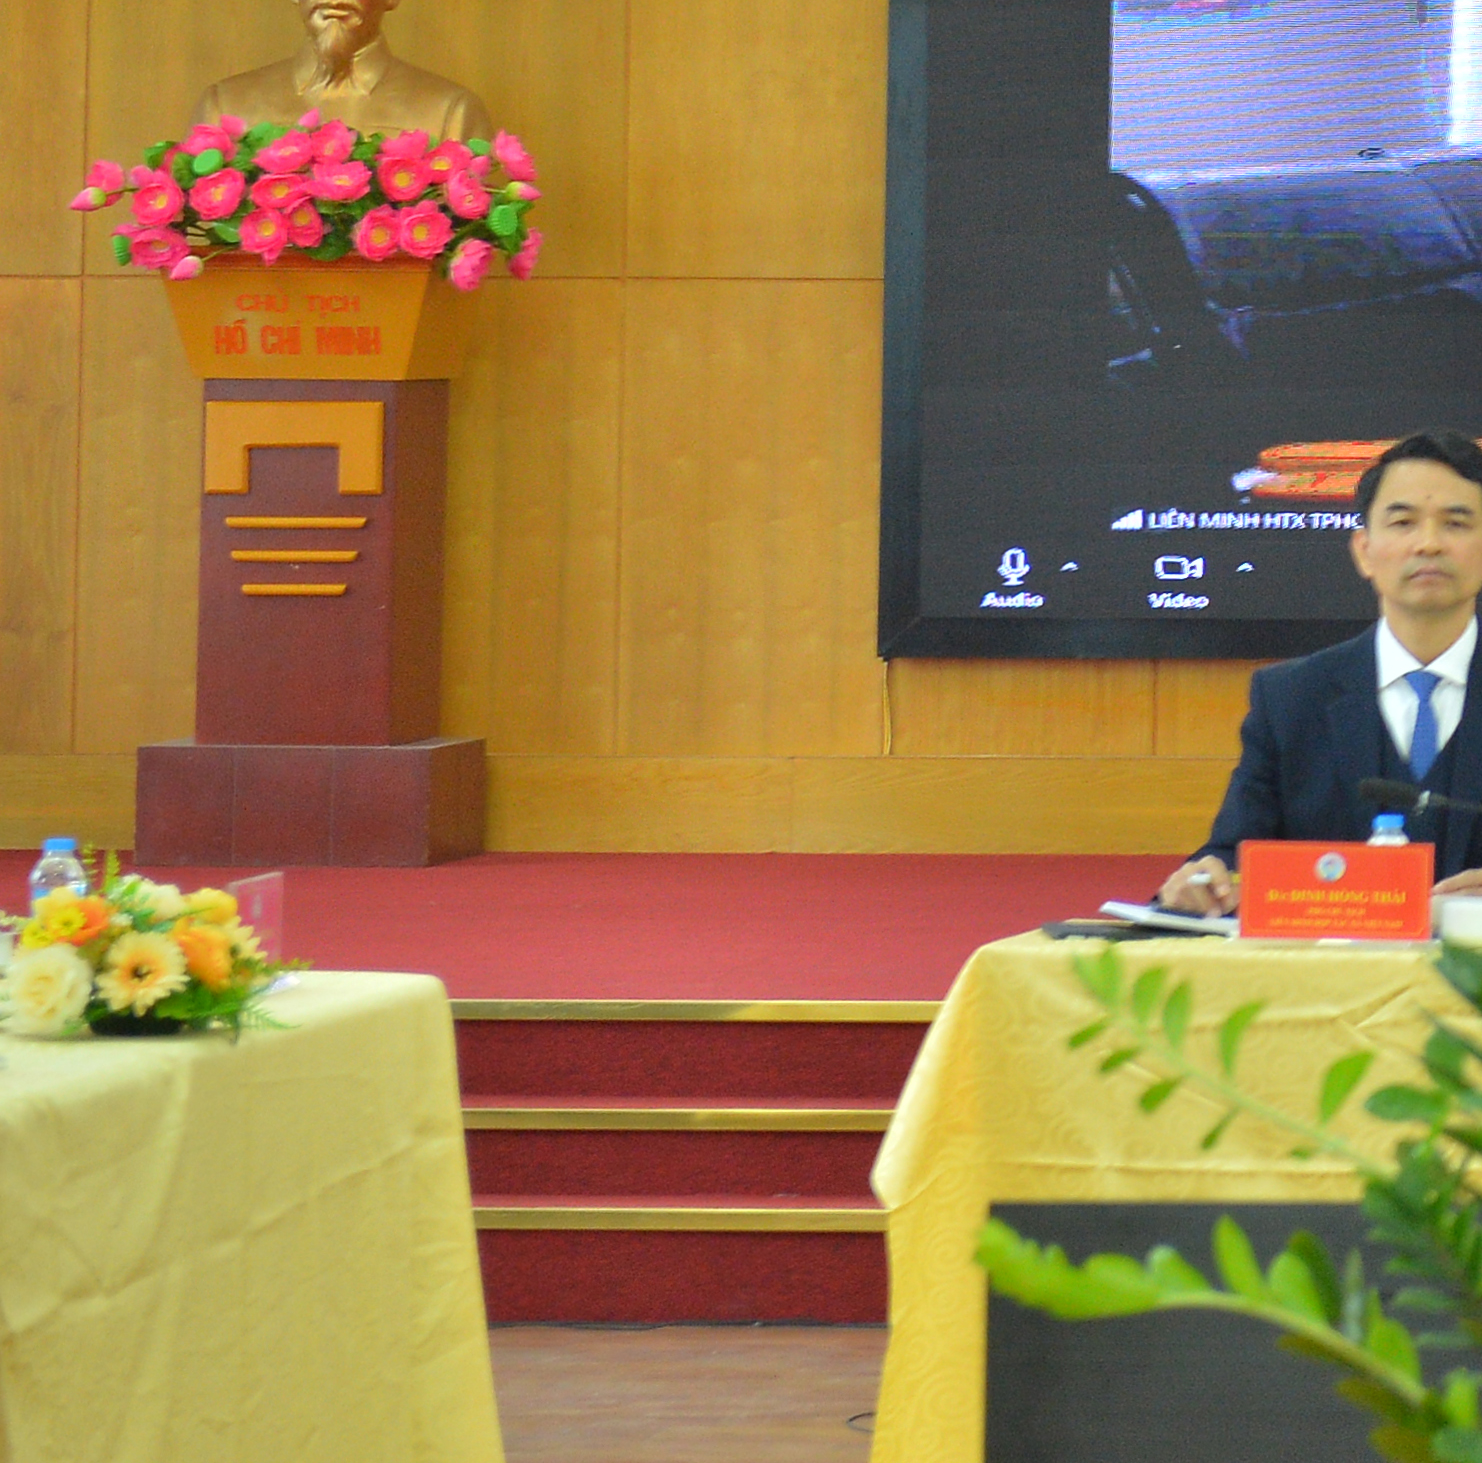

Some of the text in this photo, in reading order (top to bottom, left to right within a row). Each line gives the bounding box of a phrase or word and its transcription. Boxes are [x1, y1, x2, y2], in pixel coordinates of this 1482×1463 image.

[315, 326, 382, 355] MINH
[1149, 508, 1195, 529] LIÊN
[1199, 511, 1259, 529] MINH
[1262, 511, 1306, 529] HTX
[980, 592, 1045, 608] Audio
[1147, 592, 1210, 609] Video
